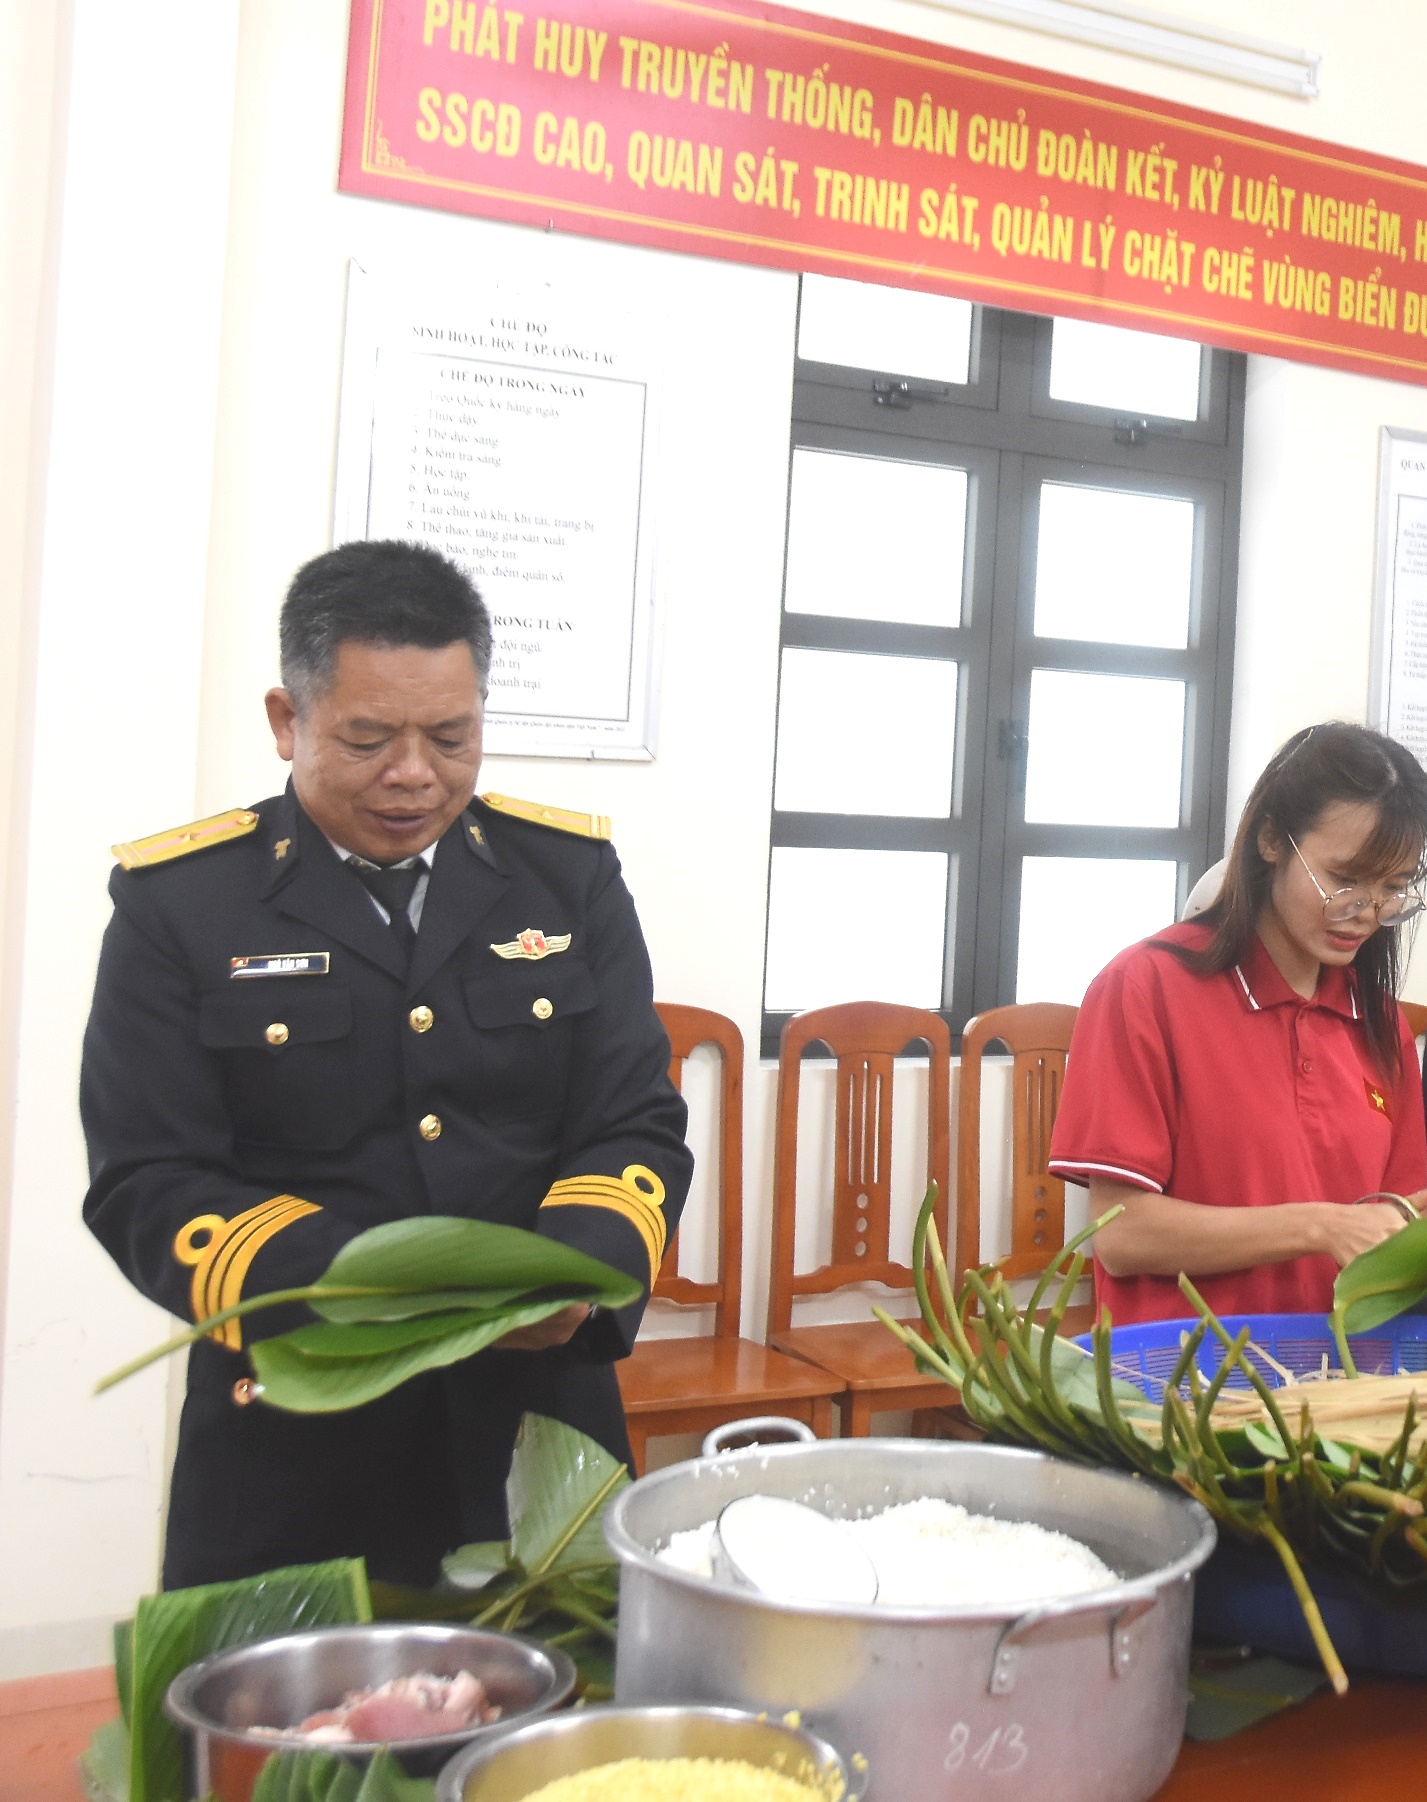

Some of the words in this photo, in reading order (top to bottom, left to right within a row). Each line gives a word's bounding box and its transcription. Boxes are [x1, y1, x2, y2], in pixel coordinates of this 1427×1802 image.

[423, 0, 524, 65] PHÁT
[534, 18, 607, 82] HUY
[619, 41, 754, 113] TRUYỀN
[765, 63, 881, 148] THỐNG,
[893, 92, 959, 157] DÂN
[968, 108, 1028, 172] CHỦ
[1037, 128, 1118, 191] ĐOÀN
[1125, 142, 1180, 211] KẾT,
[1189, 155, 1225, 214] KỶ
[1231, 175, 1295, 239] LUẬT
[1302, 199, 1407, 263] NGHIÊM,
[416, 87, 521, 157] SSCĐ
[533, 111, 614, 184] CAO,
[627, 130, 723, 197] QUAN
[733, 147, 800, 218] SÁT,
[814, 167, 910, 232] TRINH
[918, 183, 980, 251] SÁT,
[991, 195, 1074, 263] QUẢN
[1082, 214, 1116, 271] LÝ
[1123, 228, 1195, 294] CHẶT
[1202, 243, 1253, 301] CHẼ
[1263, 254, 1331, 316] VÙNG
[1338, 267, 1398, 331] BIỂN
[1400, 459, 1426, 471] QUAN
[493, 614, 533, 630] RONG
[943, 1721, 1028, 1776] 813
